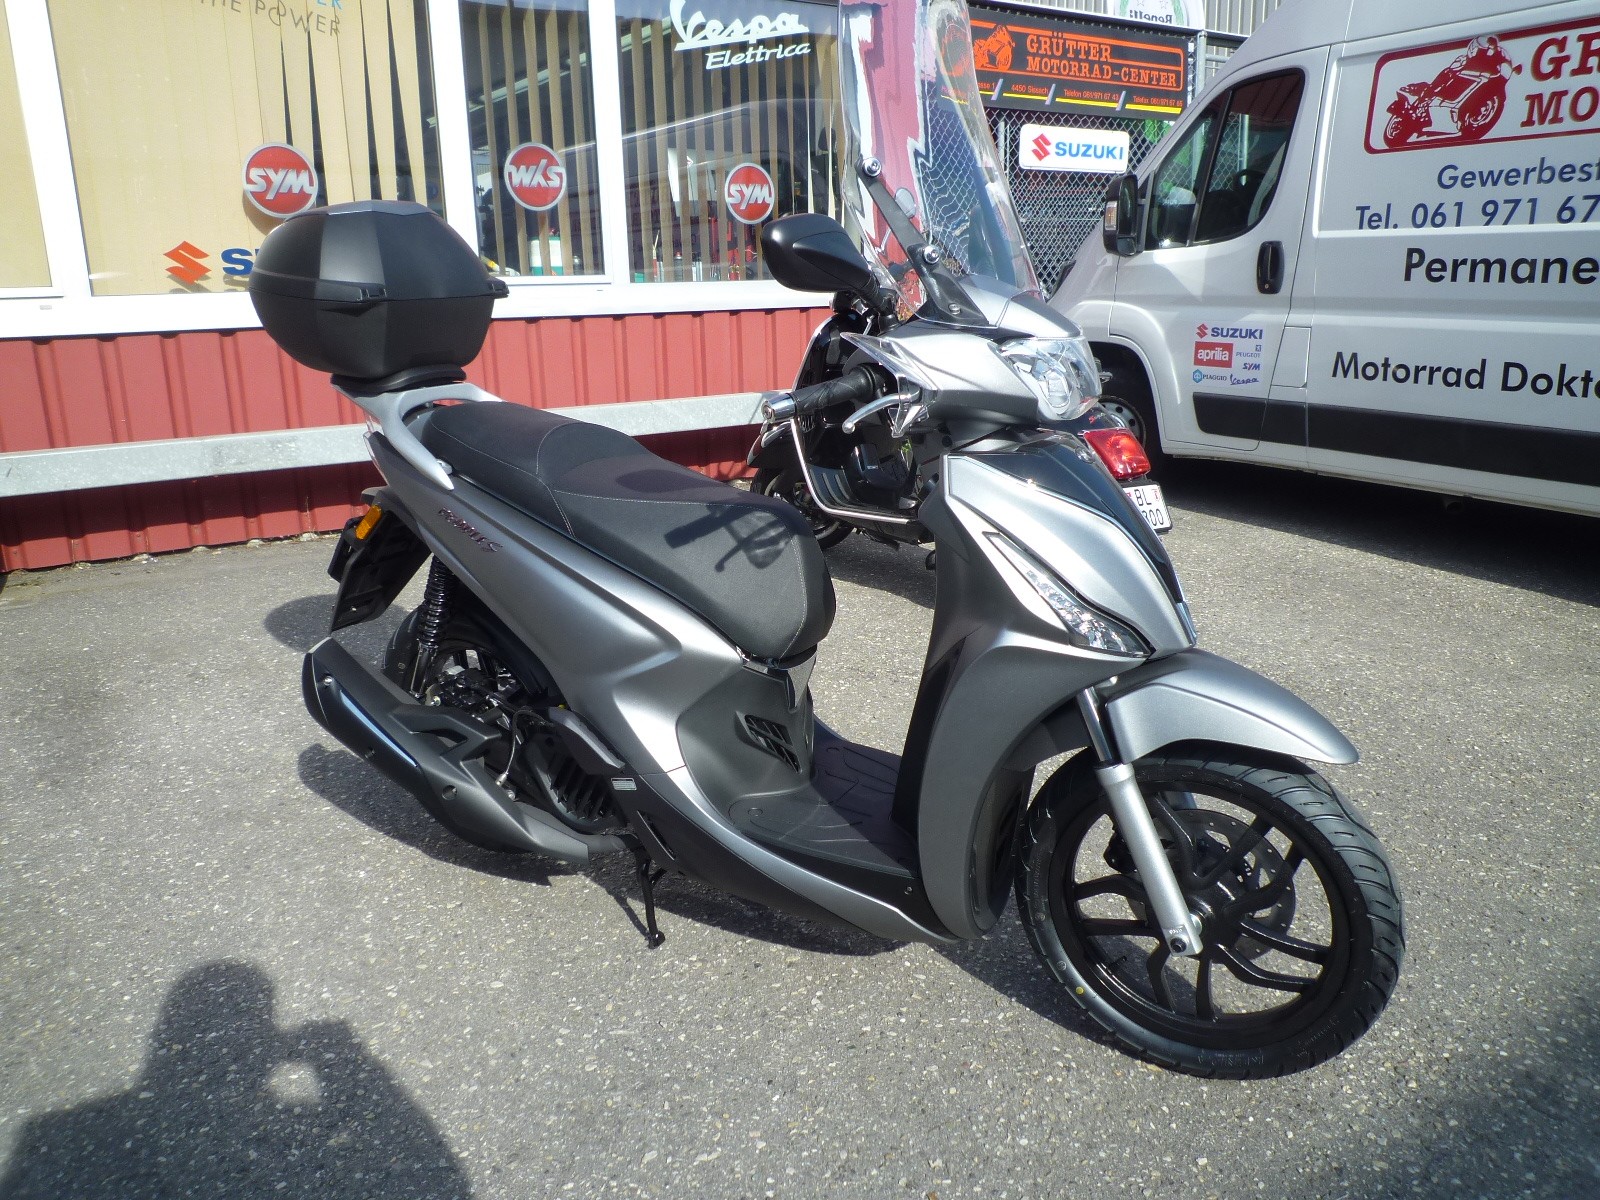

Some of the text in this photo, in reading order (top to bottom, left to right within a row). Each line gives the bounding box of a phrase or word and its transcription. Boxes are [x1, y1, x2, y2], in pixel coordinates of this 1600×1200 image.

[669, 0, 810, 51] Vespa
[705, 43, 812, 70] Elettrica
[1026, 32, 1112, 62] GRÜTTER
[1026, 56, 1177, 87] MOTORRAD-CENTER
[1011, 84, 1027, 93] 4450
[1027, 85, 1049, 94] Sissach
[1064, 89, 1081, 98] Telefon
[1133, 95, 1149, 104] Telefax
[1520, 86, 1600, 127] MO
[1055, 142, 1123, 160] SUZUKI
[247, 168, 314, 200] SYM
[728, 184, 773, 210] SYM
[1355, 195, 1600, 230] Tel. 061 971 67
[221, 248, 259, 275] S
[1404, 247, 1600, 285] Permane
[1211, 327, 1263, 339] SUZUKI
[1197, 347, 1229, 361] aprilia
[1242, 363, 1260, 371] SYM
[1230, 374, 1259, 385] Vespa
[1331, 351, 1487, 389] Motorrad
[1134, 488, 1152, 506] BL
